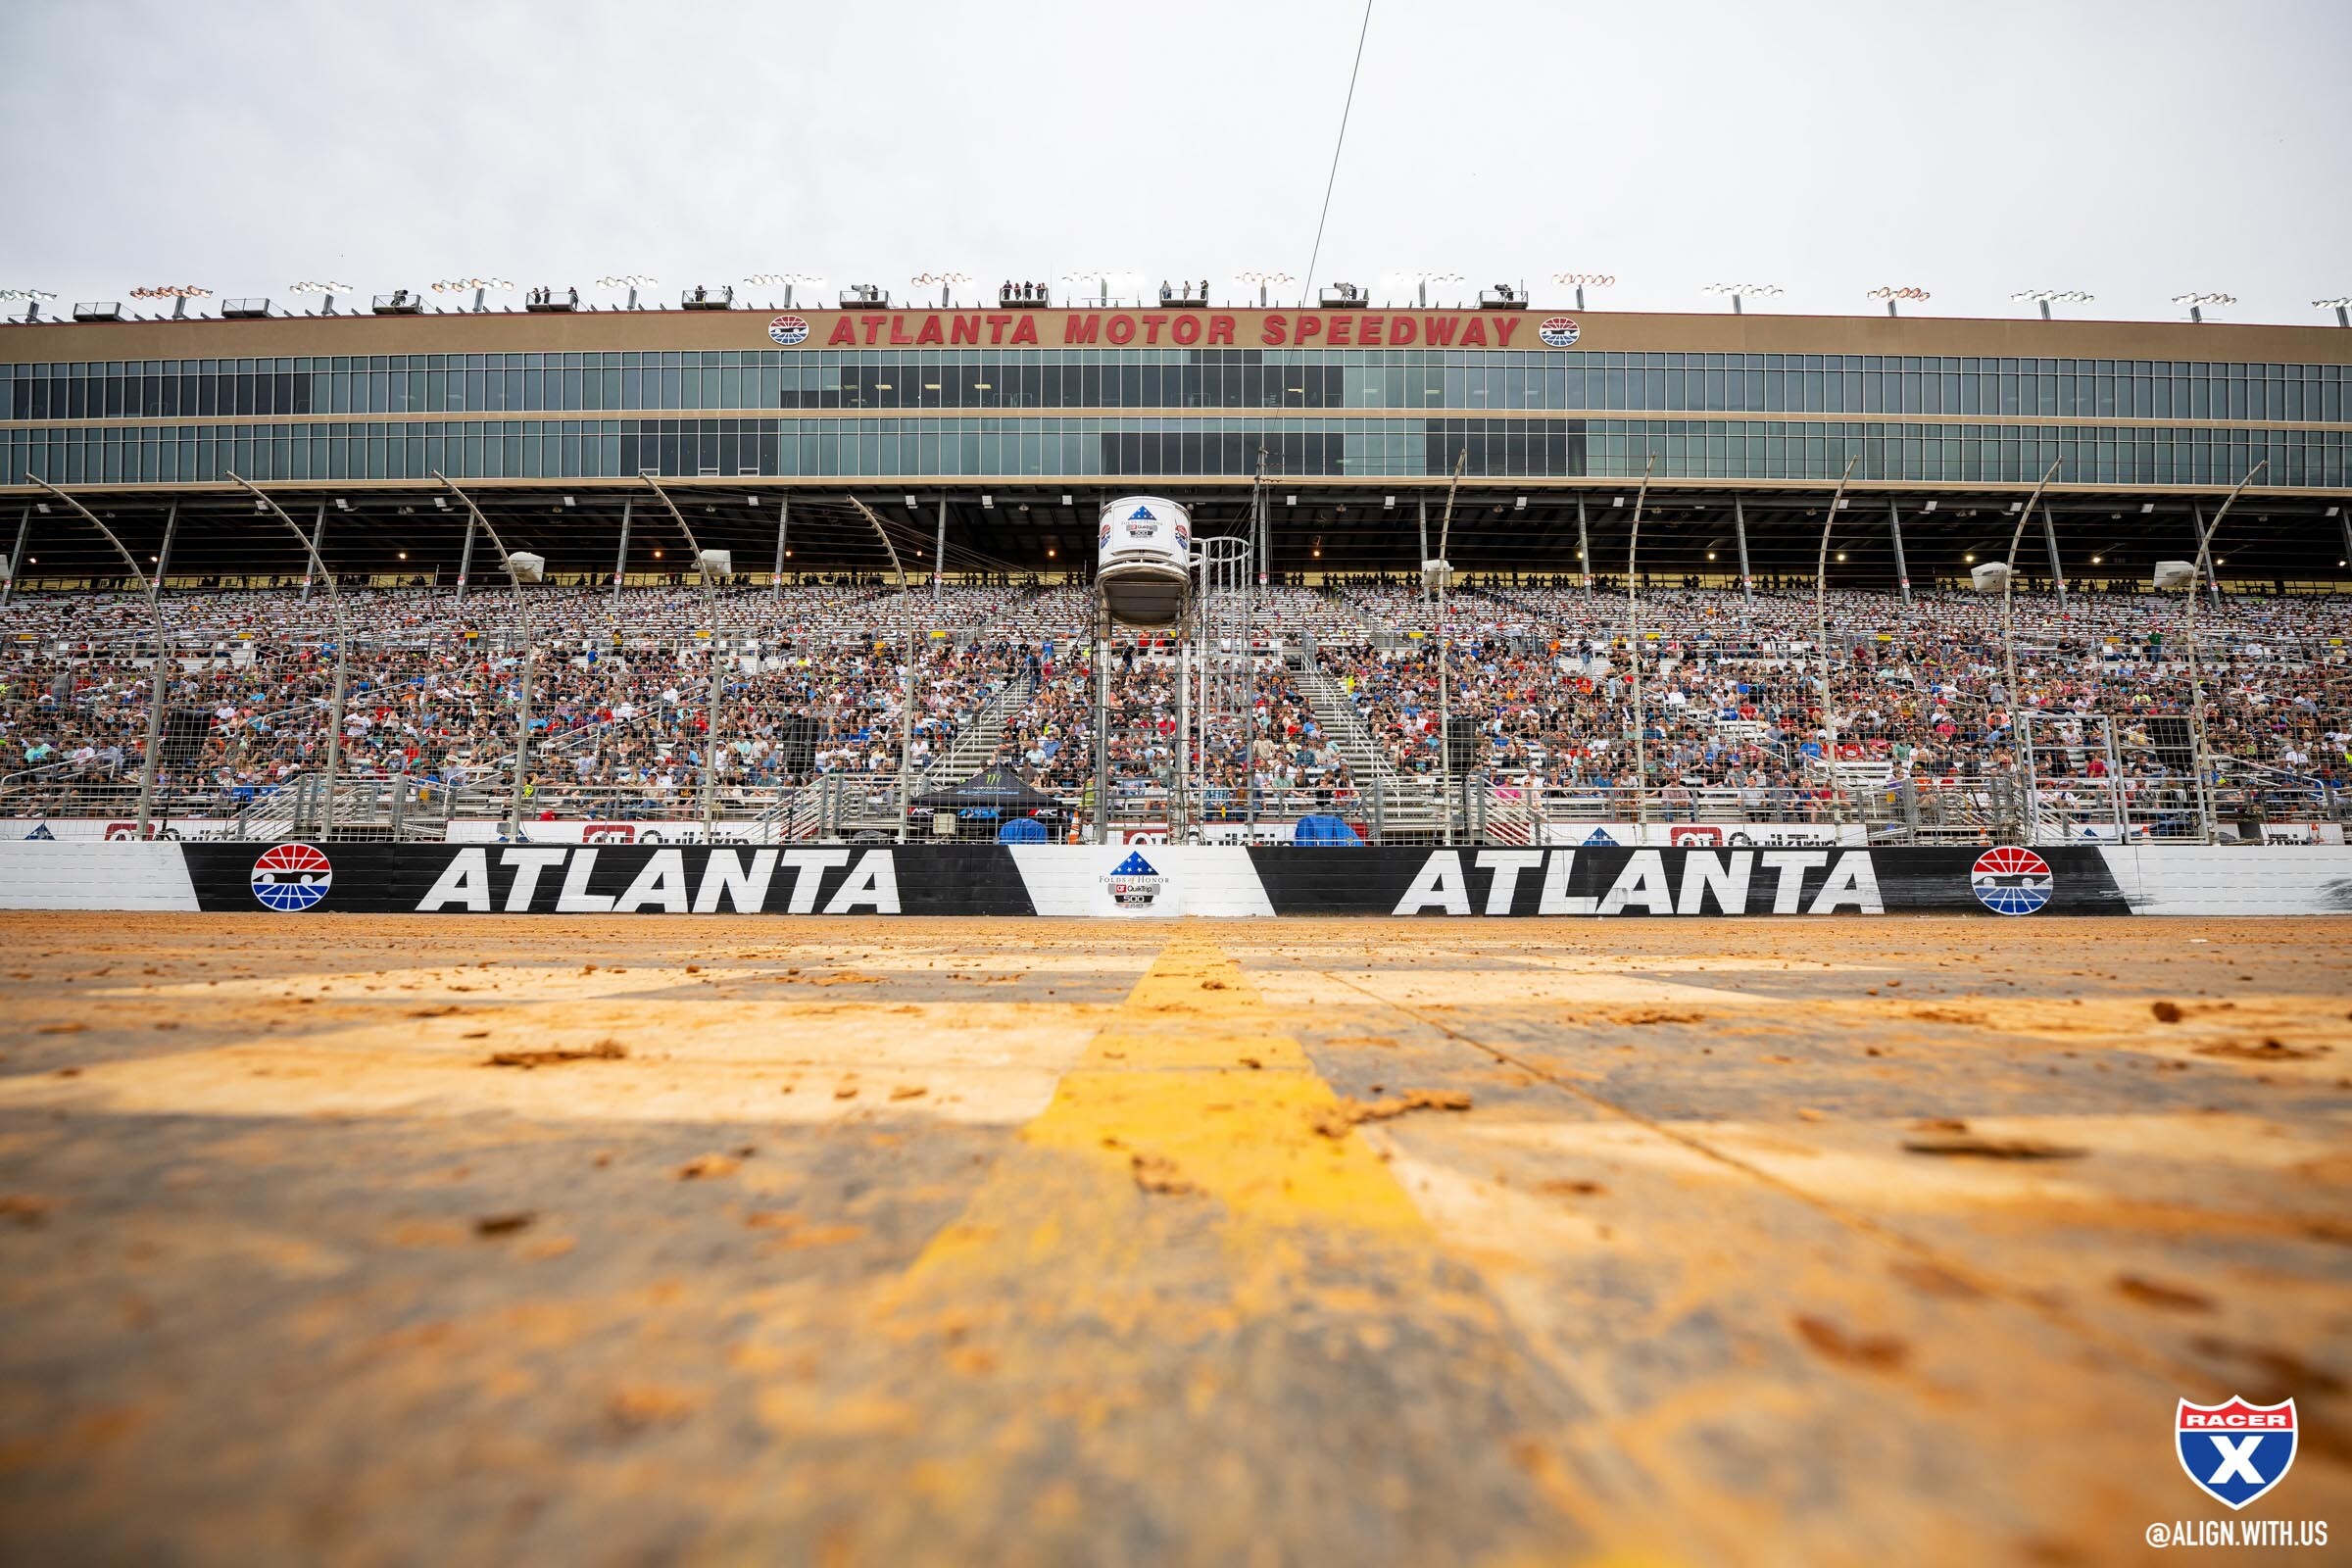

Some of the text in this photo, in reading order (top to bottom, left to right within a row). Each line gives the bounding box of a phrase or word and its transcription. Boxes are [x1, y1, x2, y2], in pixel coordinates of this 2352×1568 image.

[828, 315, 1521, 346] ATLANTA MOTOR SPEEDWAY
[415, 848, 901, 913] ATLANTA
[1392, 850, 1886, 914] ATLANTA
